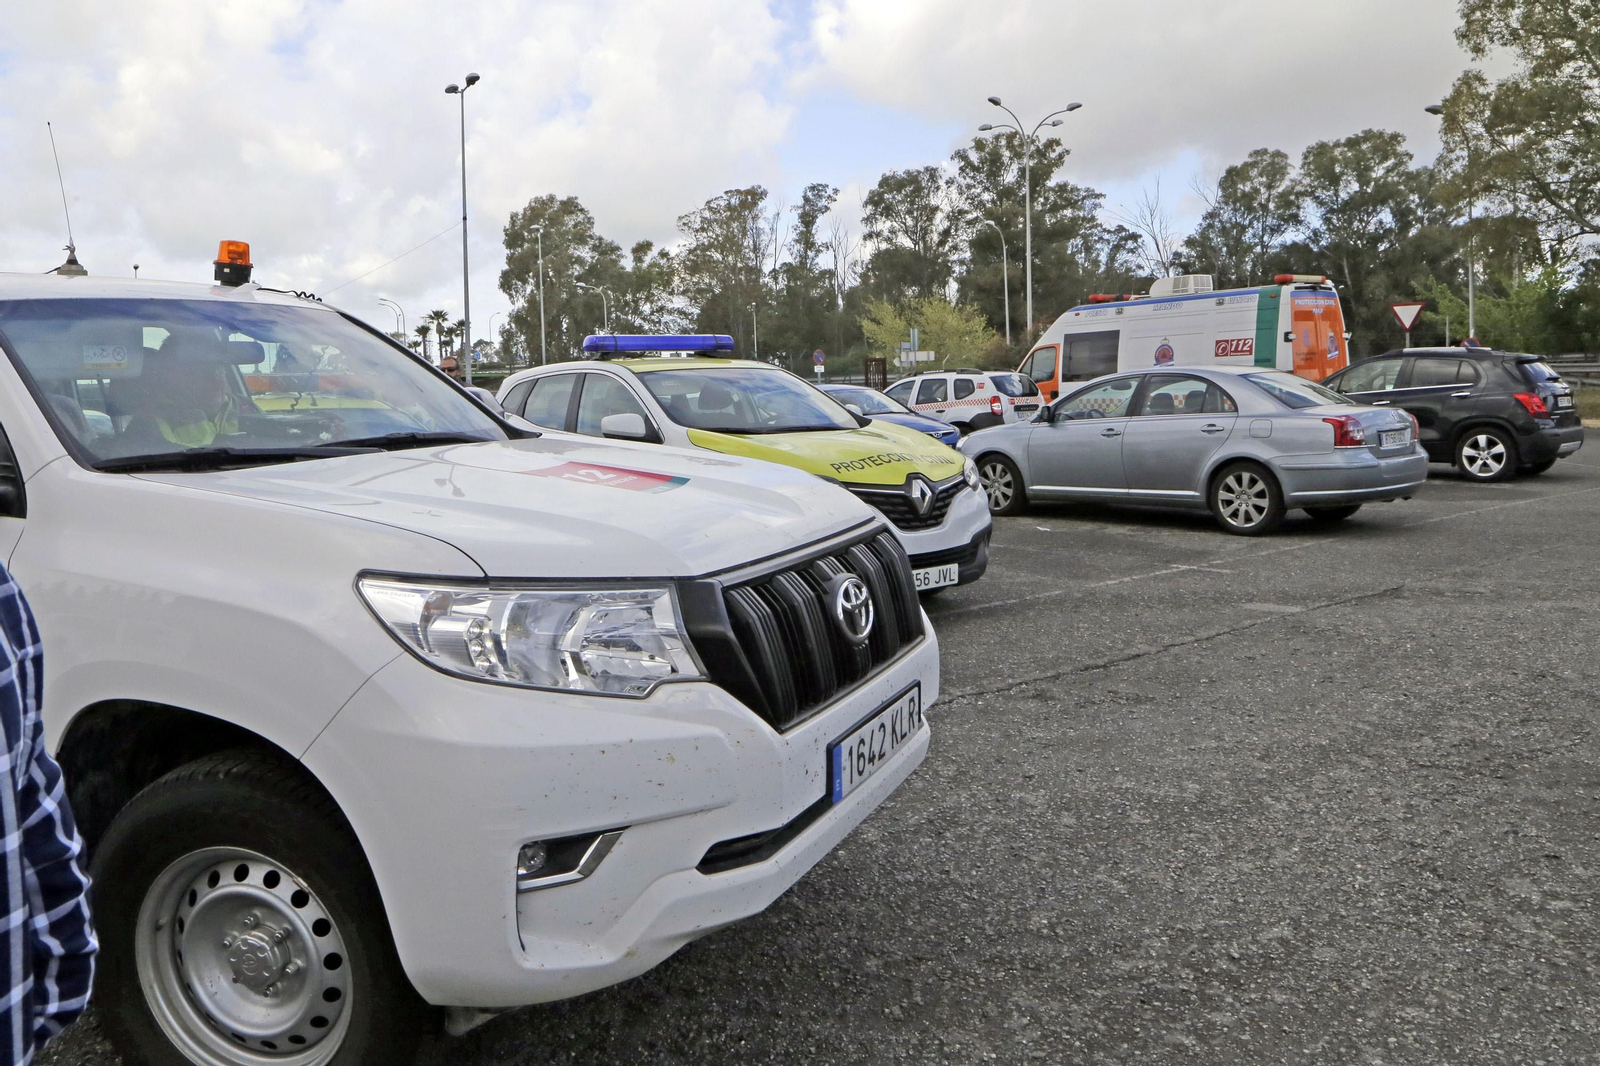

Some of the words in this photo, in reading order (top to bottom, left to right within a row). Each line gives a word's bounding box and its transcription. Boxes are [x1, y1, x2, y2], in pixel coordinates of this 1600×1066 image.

[1153, 302, 1183, 311] MANDO
[1231, 339, 1252, 351] 112
[912, 571, 930, 587] 56
[934, 567, 956, 584] JVL
[848, 722, 886, 784] 1642
[891, 696, 916, 749] KLR
